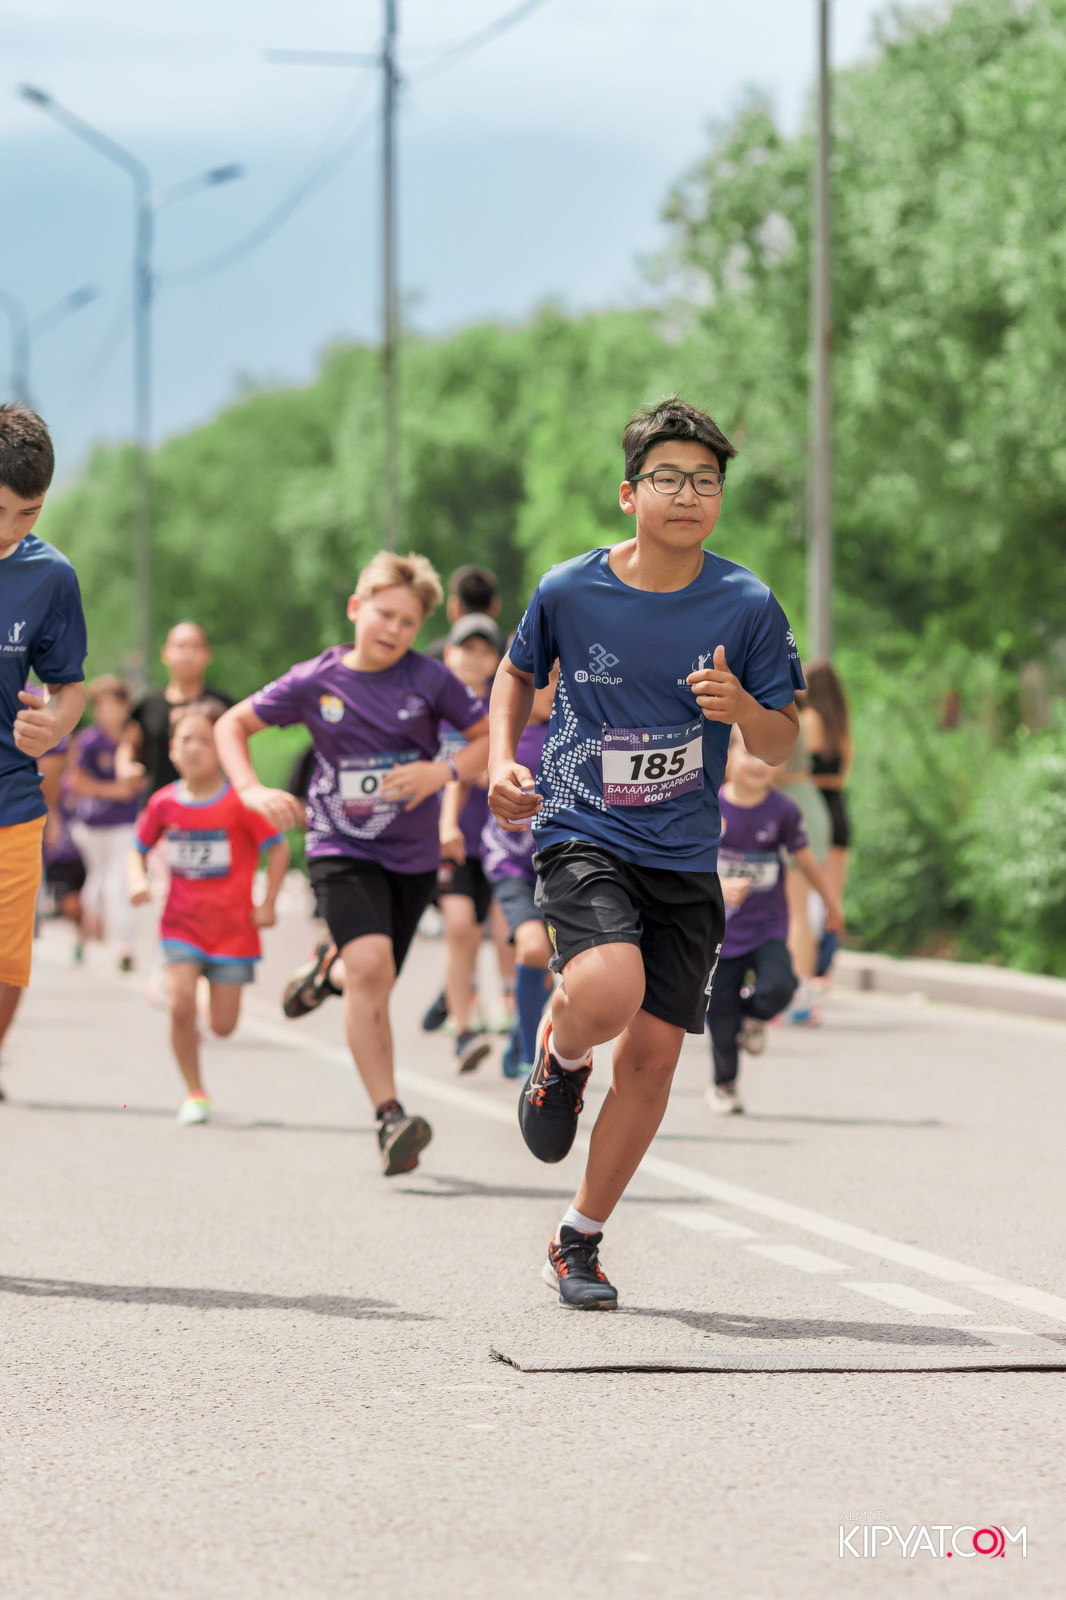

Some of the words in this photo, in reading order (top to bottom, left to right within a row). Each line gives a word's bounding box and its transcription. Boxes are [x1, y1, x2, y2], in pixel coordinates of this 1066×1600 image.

[576, 672, 587, 681] BI
[589, 674, 623, 685] GROUP
[630, 747, 688, 781] 185
[360, 774, 382, 795] 0
[607, 784, 658, 794] БАЛАЛАР
[659, 770, 699, 791] ЖАРЫСЫ
[644, 792, 664, 803] 600
